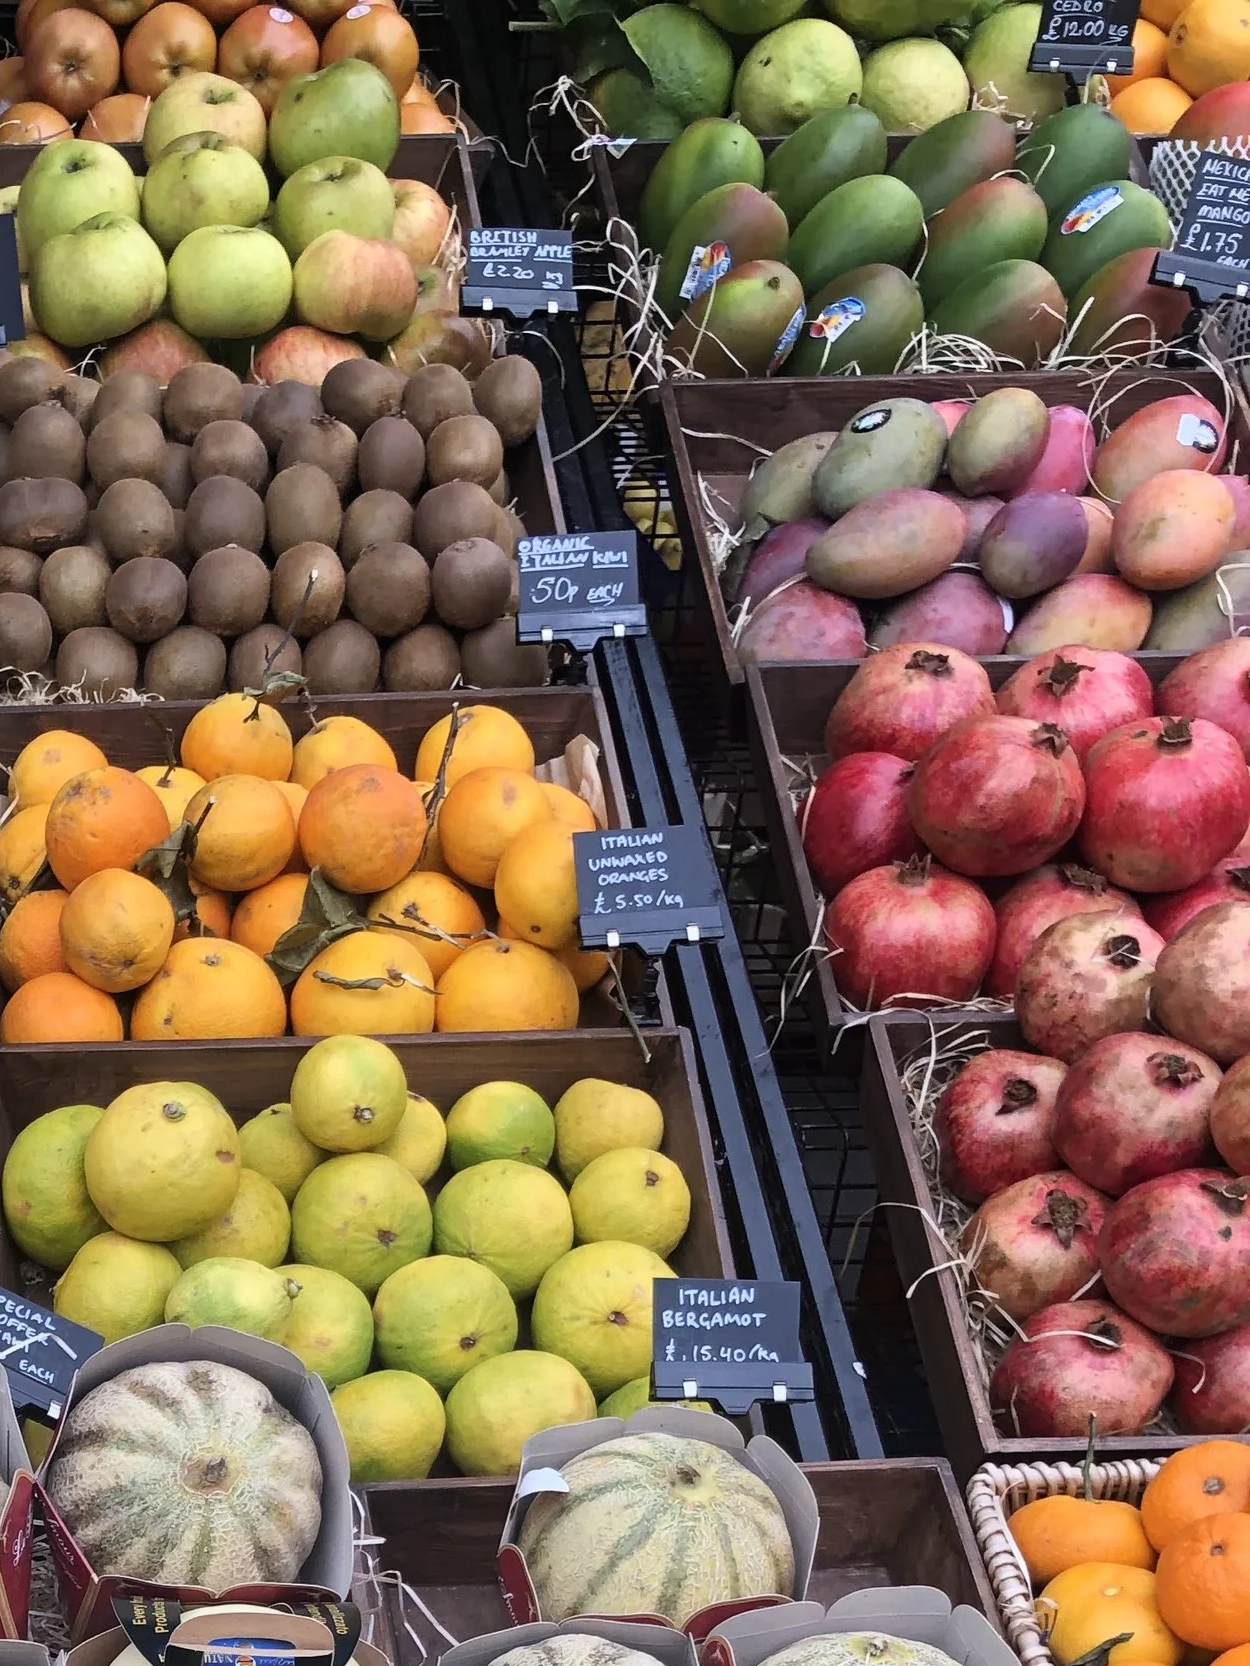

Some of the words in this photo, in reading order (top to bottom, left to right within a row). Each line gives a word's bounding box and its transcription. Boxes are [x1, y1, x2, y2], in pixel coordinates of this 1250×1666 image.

[1196, 183, 1229, 197] EAT
[470, 231, 537, 243] BRITISH
[1180, 223, 1243, 254] £1.75
[534, 245, 572, 258] APPLE
[518, 536, 591, 553] ORGANIC
[520, 552, 589, 568] ITALIAN
[586, 582, 624, 600] EACH
[600, 832, 663, 850] ITALIAN
[588, 851, 668, 871] UNWAXED
[598, 868, 669, 886] ORANGES
[679, 1286, 755, 1306] ITALIAN
[662, 1310, 767, 1330] BERGAMOT
[19, 1359, 54, 1384] EACH
